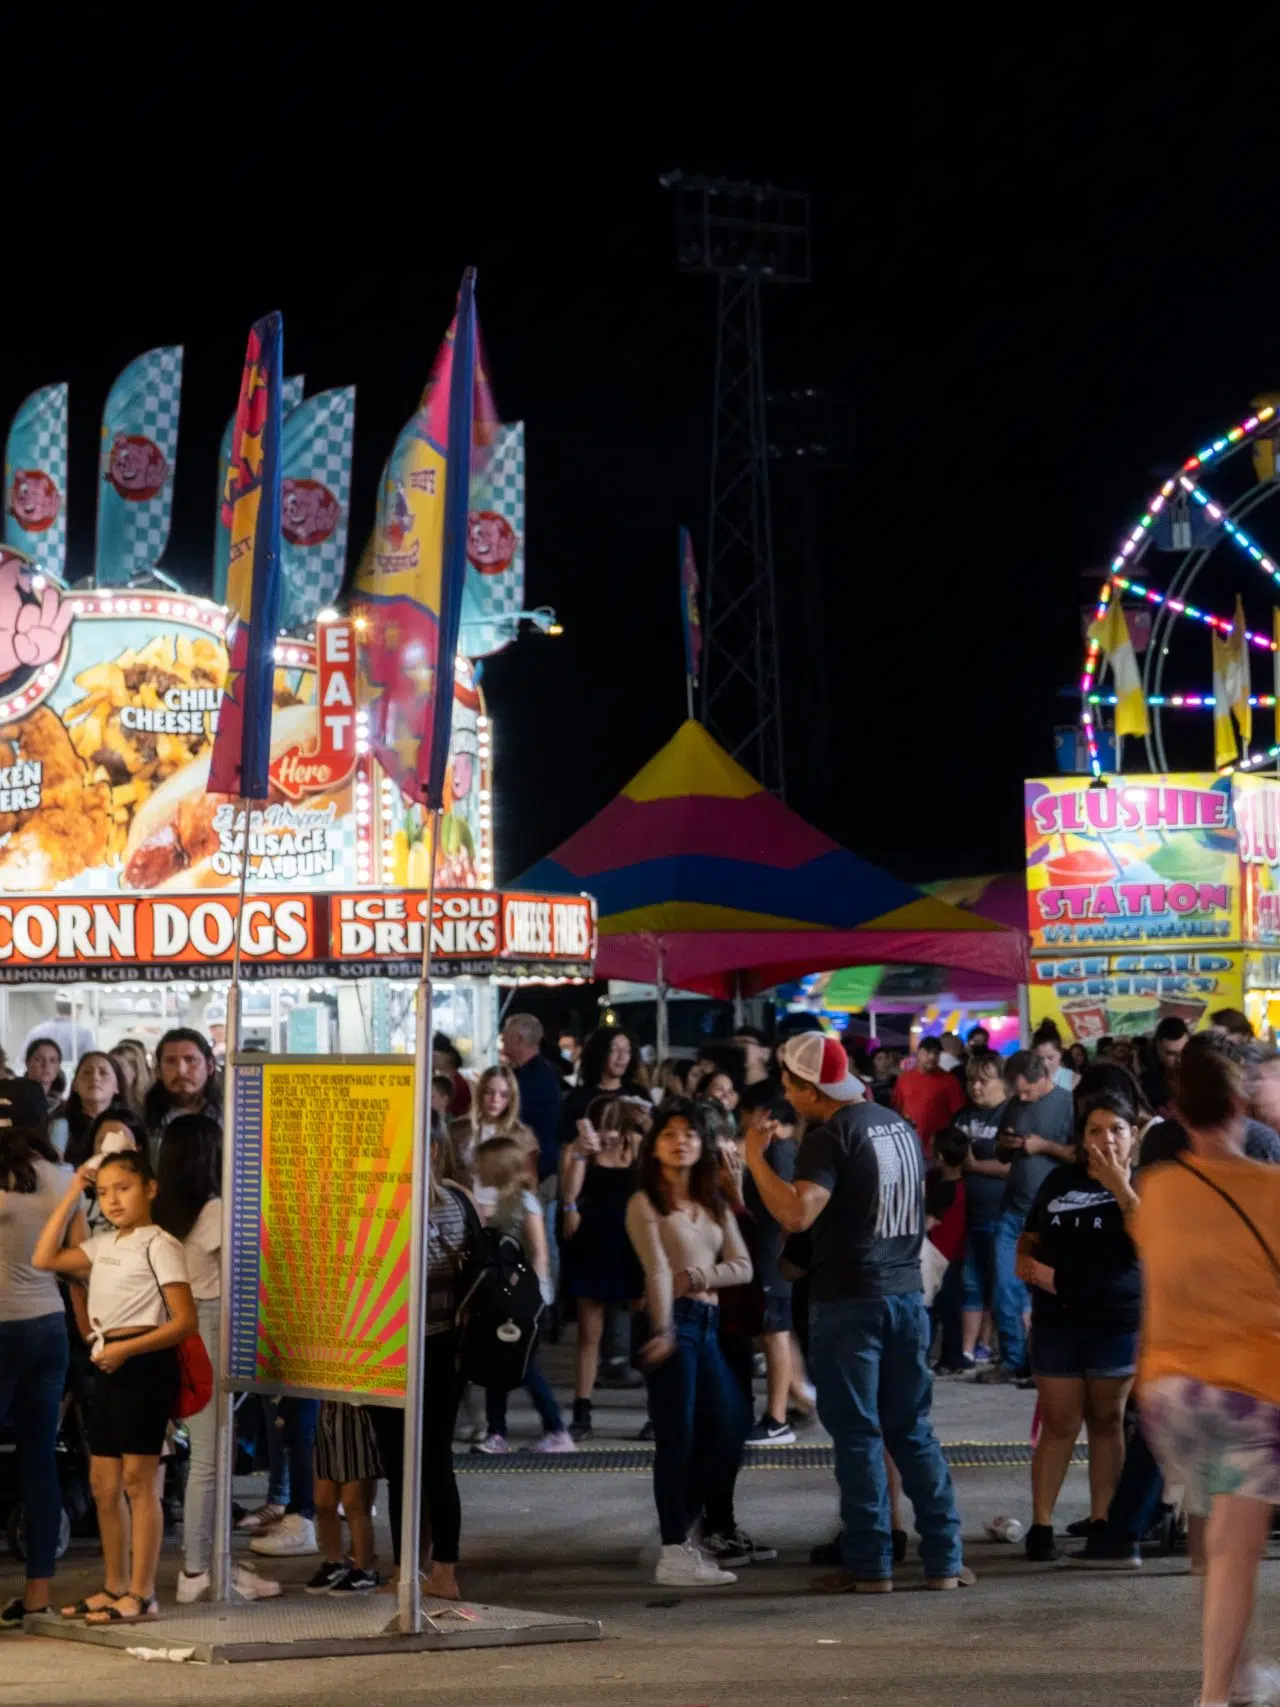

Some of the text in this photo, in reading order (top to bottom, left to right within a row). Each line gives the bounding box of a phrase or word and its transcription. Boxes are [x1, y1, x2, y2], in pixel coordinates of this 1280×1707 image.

[325, 627, 352, 750] EAT
[120, 706, 205, 734] CHEESE
[279, 756, 332, 784] Here
[1032, 785, 1229, 835] SLUSHIE
[219, 828, 327, 855] SAUSAGE
[341, 897, 498, 919] ICE COLD
[1037, 882, 1232, 919] STATION
[151, 900, 308, 957] DOGS
[341, 920, 496, 955] DRINKS
[505, 900, 590, 955] CHEESE FRIES
[1075, 922, 1143, 942] PRICE
[102, 966, 137, 981] ICED
[144, 965, 175, 980] TEA
[340, 963, 381, 976] SOFT
[1037, 953, 1233, 980] ICE COLD
[1053, 976, 1218, 998] DRINKS
[867, 1122, 906, 1138] ARIAT
[1051, 1214, 1102, 1229] AIR
